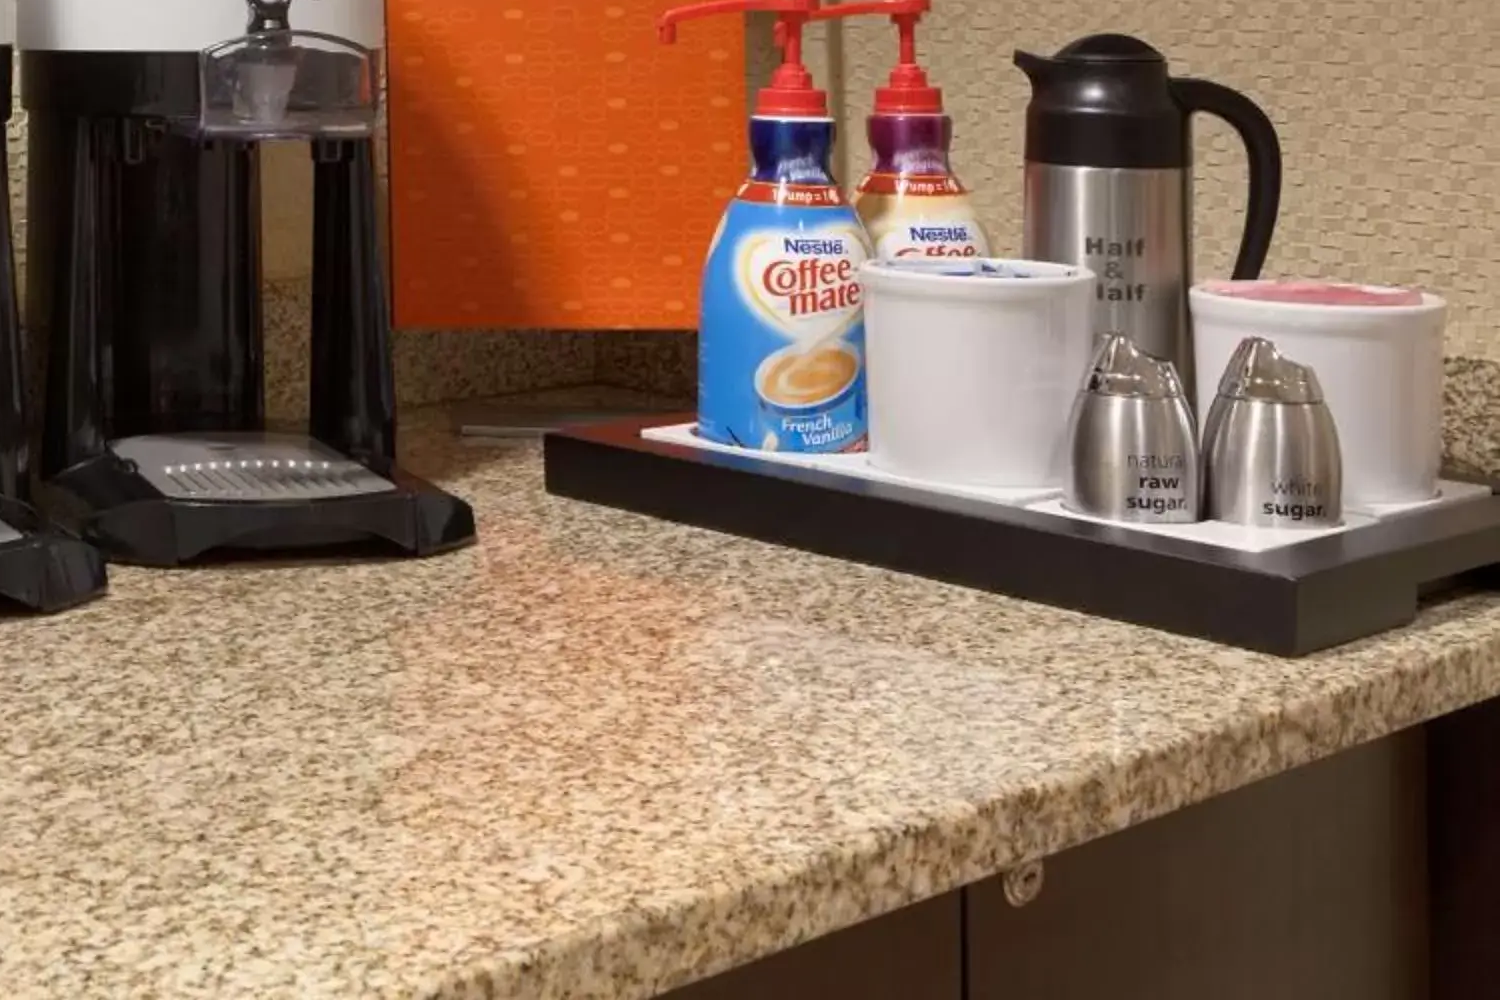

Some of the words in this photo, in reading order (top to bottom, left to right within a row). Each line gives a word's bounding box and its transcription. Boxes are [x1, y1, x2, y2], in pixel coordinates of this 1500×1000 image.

[1086, 237, 1144, 256] Half
[763, 258, 851, 296] Coffee
[1105, 261, 1123, 279] &
[790, 282, 860, 315] mate
[782, 414, 831, 432] French
[1139, 476, 1179, 489] raw
[1126, 496, 1187, 514] sugar.
[1263, 502, 1327, 520] sugar.
